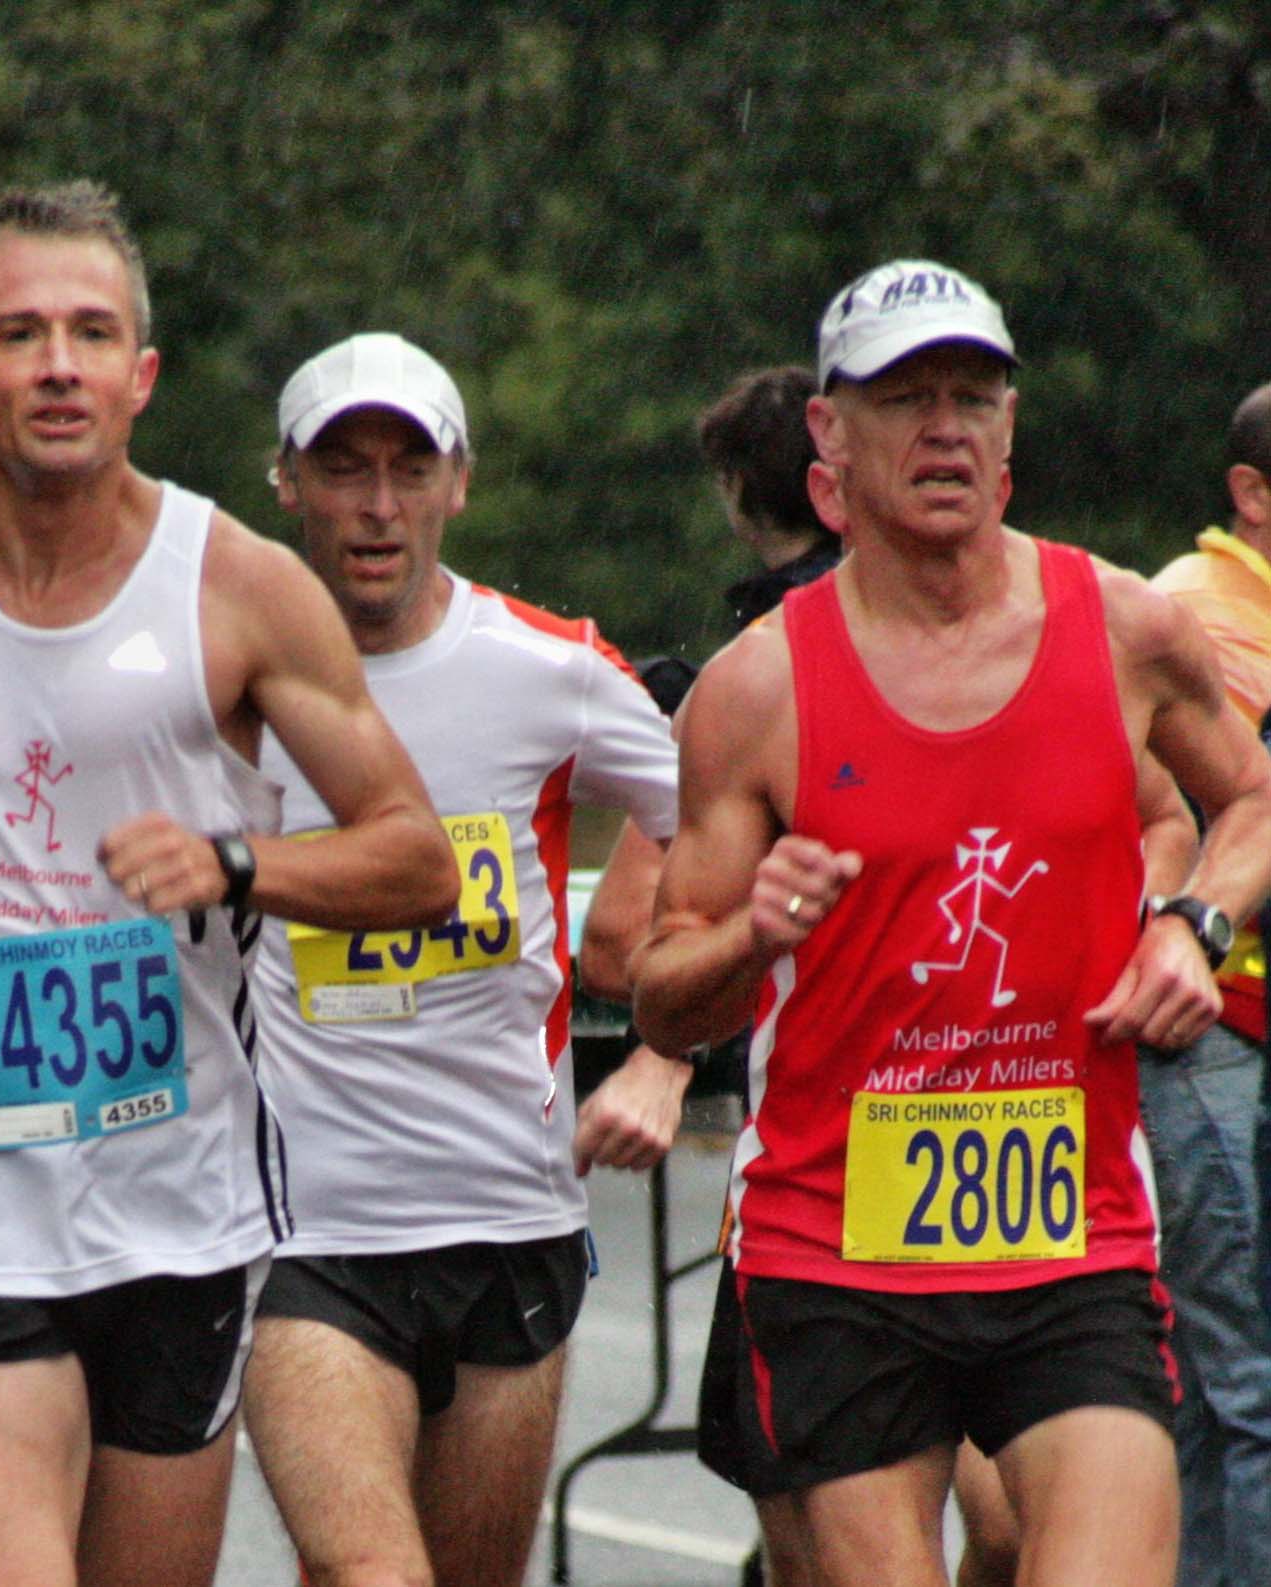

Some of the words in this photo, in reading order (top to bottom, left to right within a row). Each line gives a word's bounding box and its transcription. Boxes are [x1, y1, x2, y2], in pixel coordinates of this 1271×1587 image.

[451, 822, 489, 843] CES
[83, 926, 155, 955] RACES
[1, 954, 177, 1089] 4355
[893, 1019, 1057, 1051] Melbourne
[864, 1065, 981, 1092] Midday
[990, 1057, 1075, 1085] Milers
[106, 1093, 168, 1125] 4355
[866, 1102, 898, 1122] SRI
[904, 1102, 997, 1122] CHINMOY
[1002, 1098, 1066, 1119] RACES
[902, 1124, 1077, 1247] 2806
